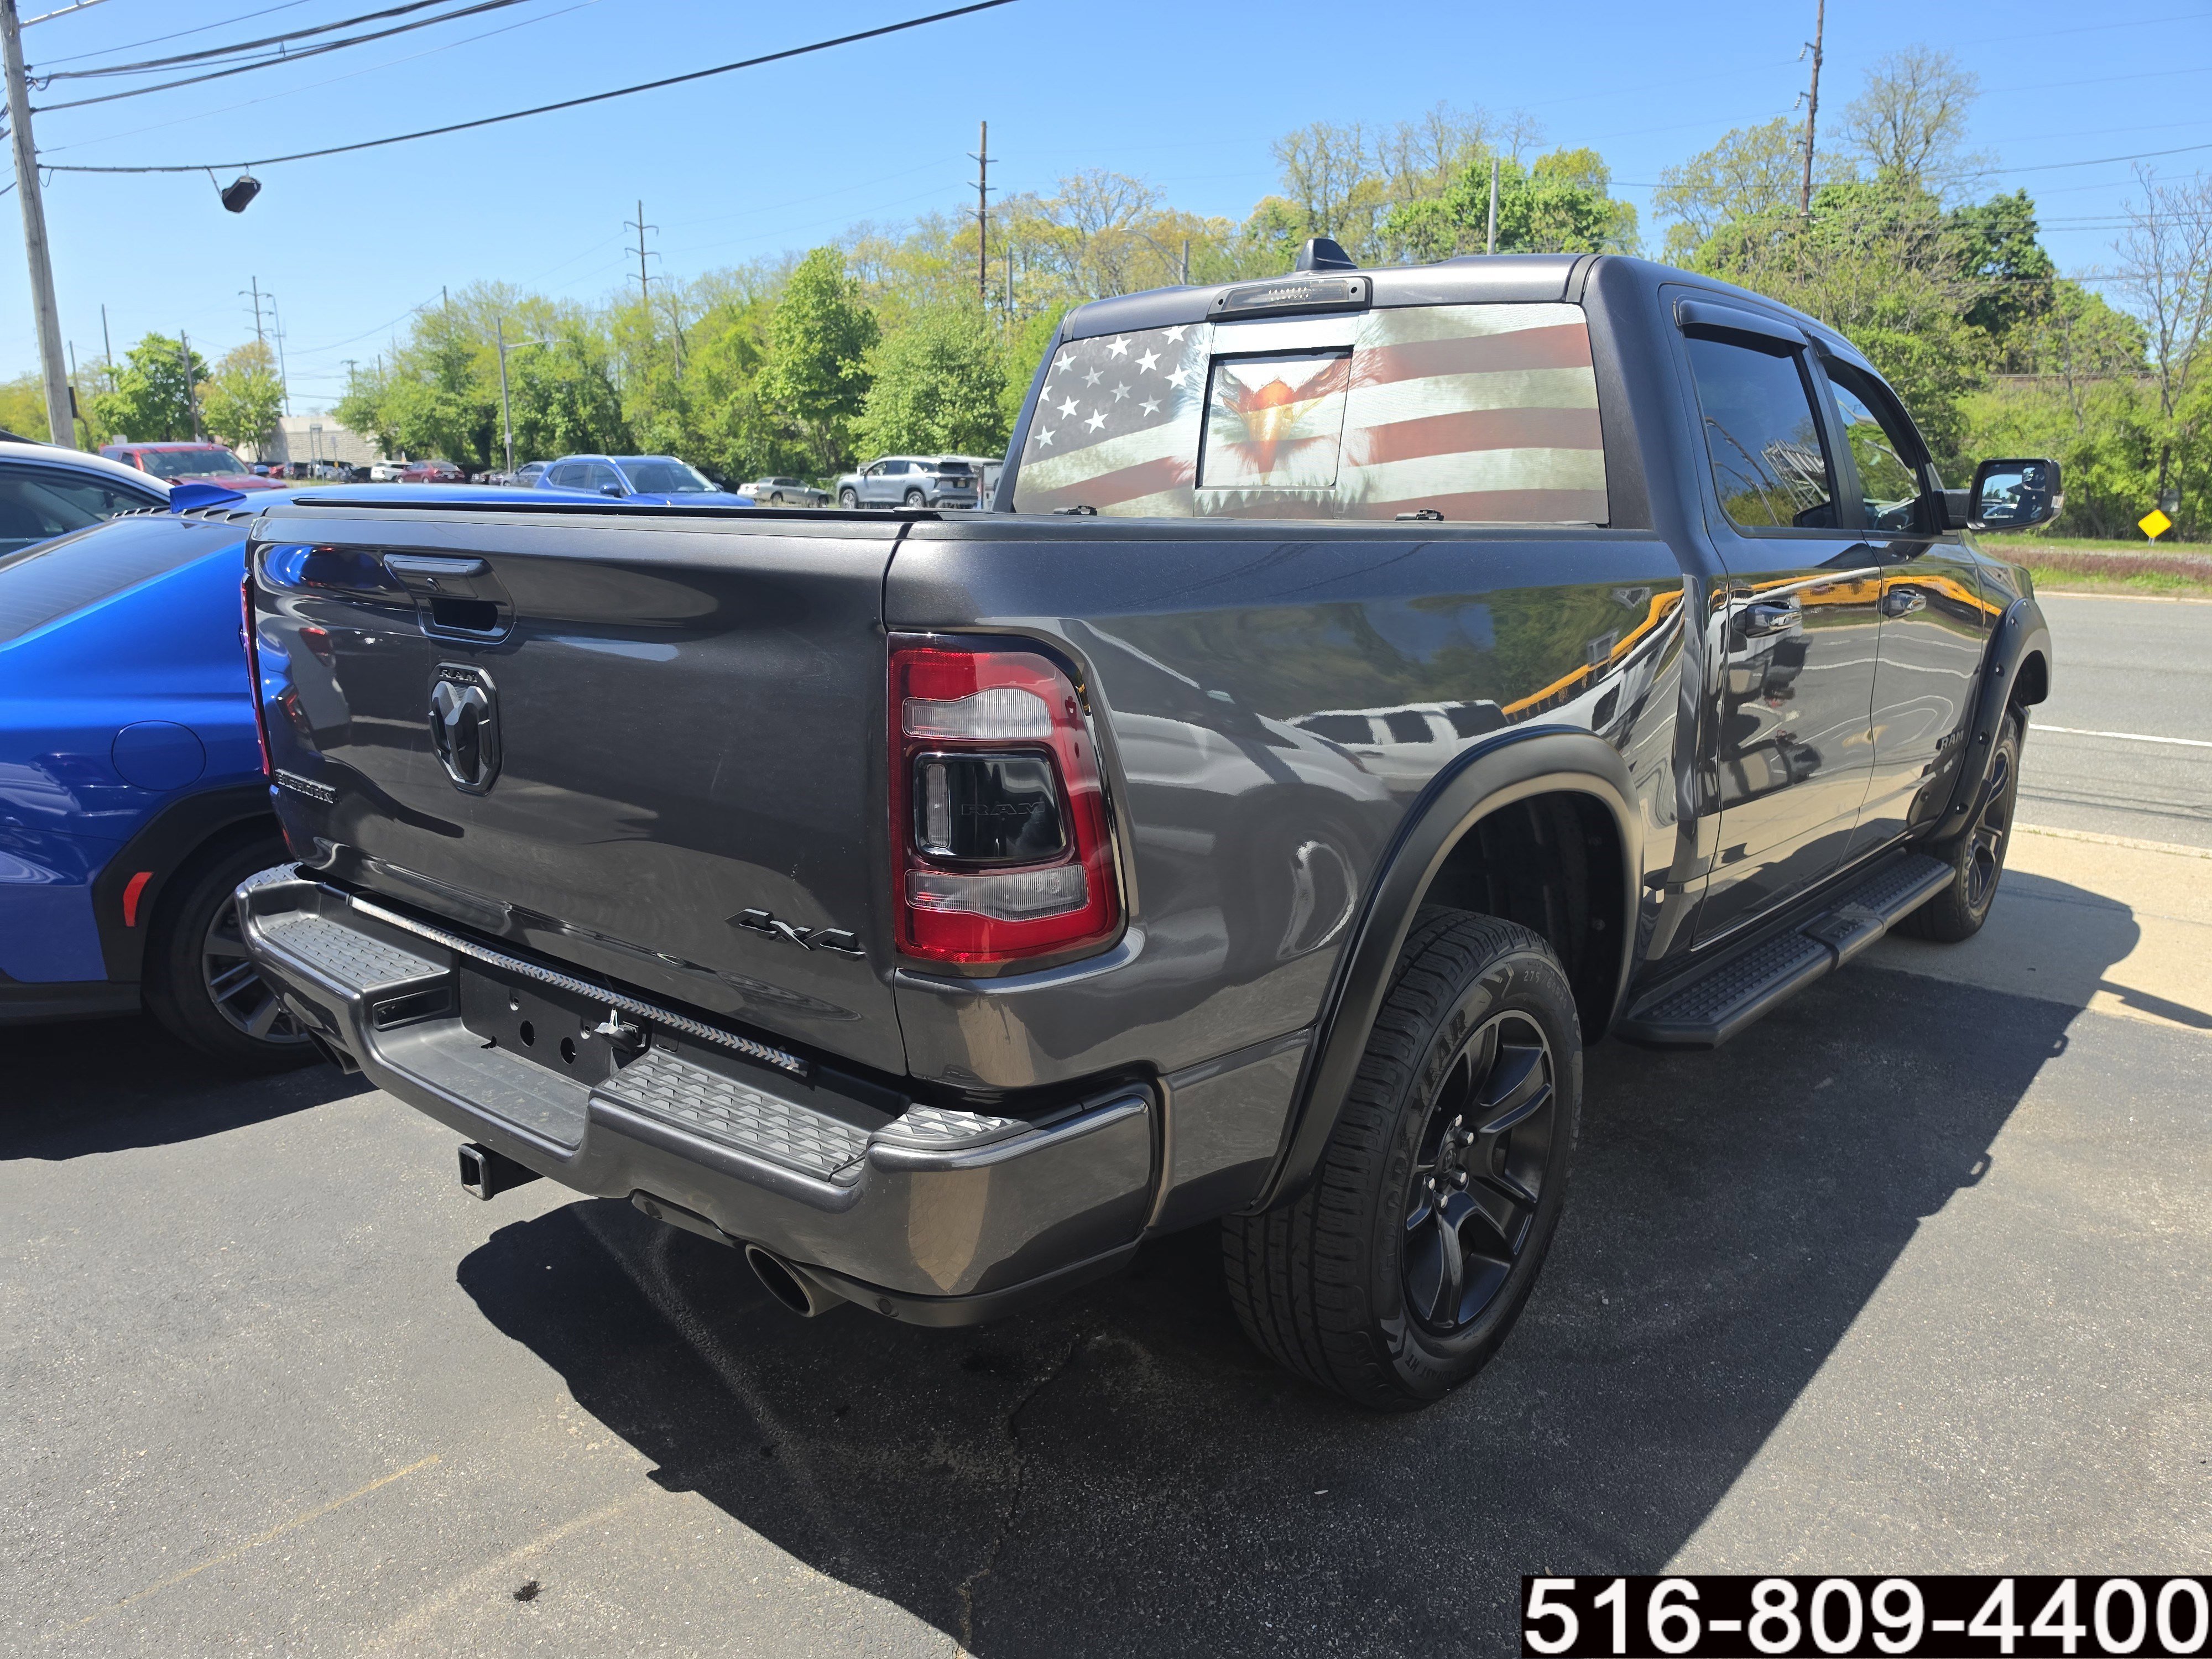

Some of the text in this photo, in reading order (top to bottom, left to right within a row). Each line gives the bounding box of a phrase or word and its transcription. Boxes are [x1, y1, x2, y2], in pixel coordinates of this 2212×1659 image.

[439, 669, 477, 682] RAM
[1940, 729, 1964, 752] RAM
[962, 801, 1045, 816] RAM
[1405, 1353, 1420, 1373] HT
